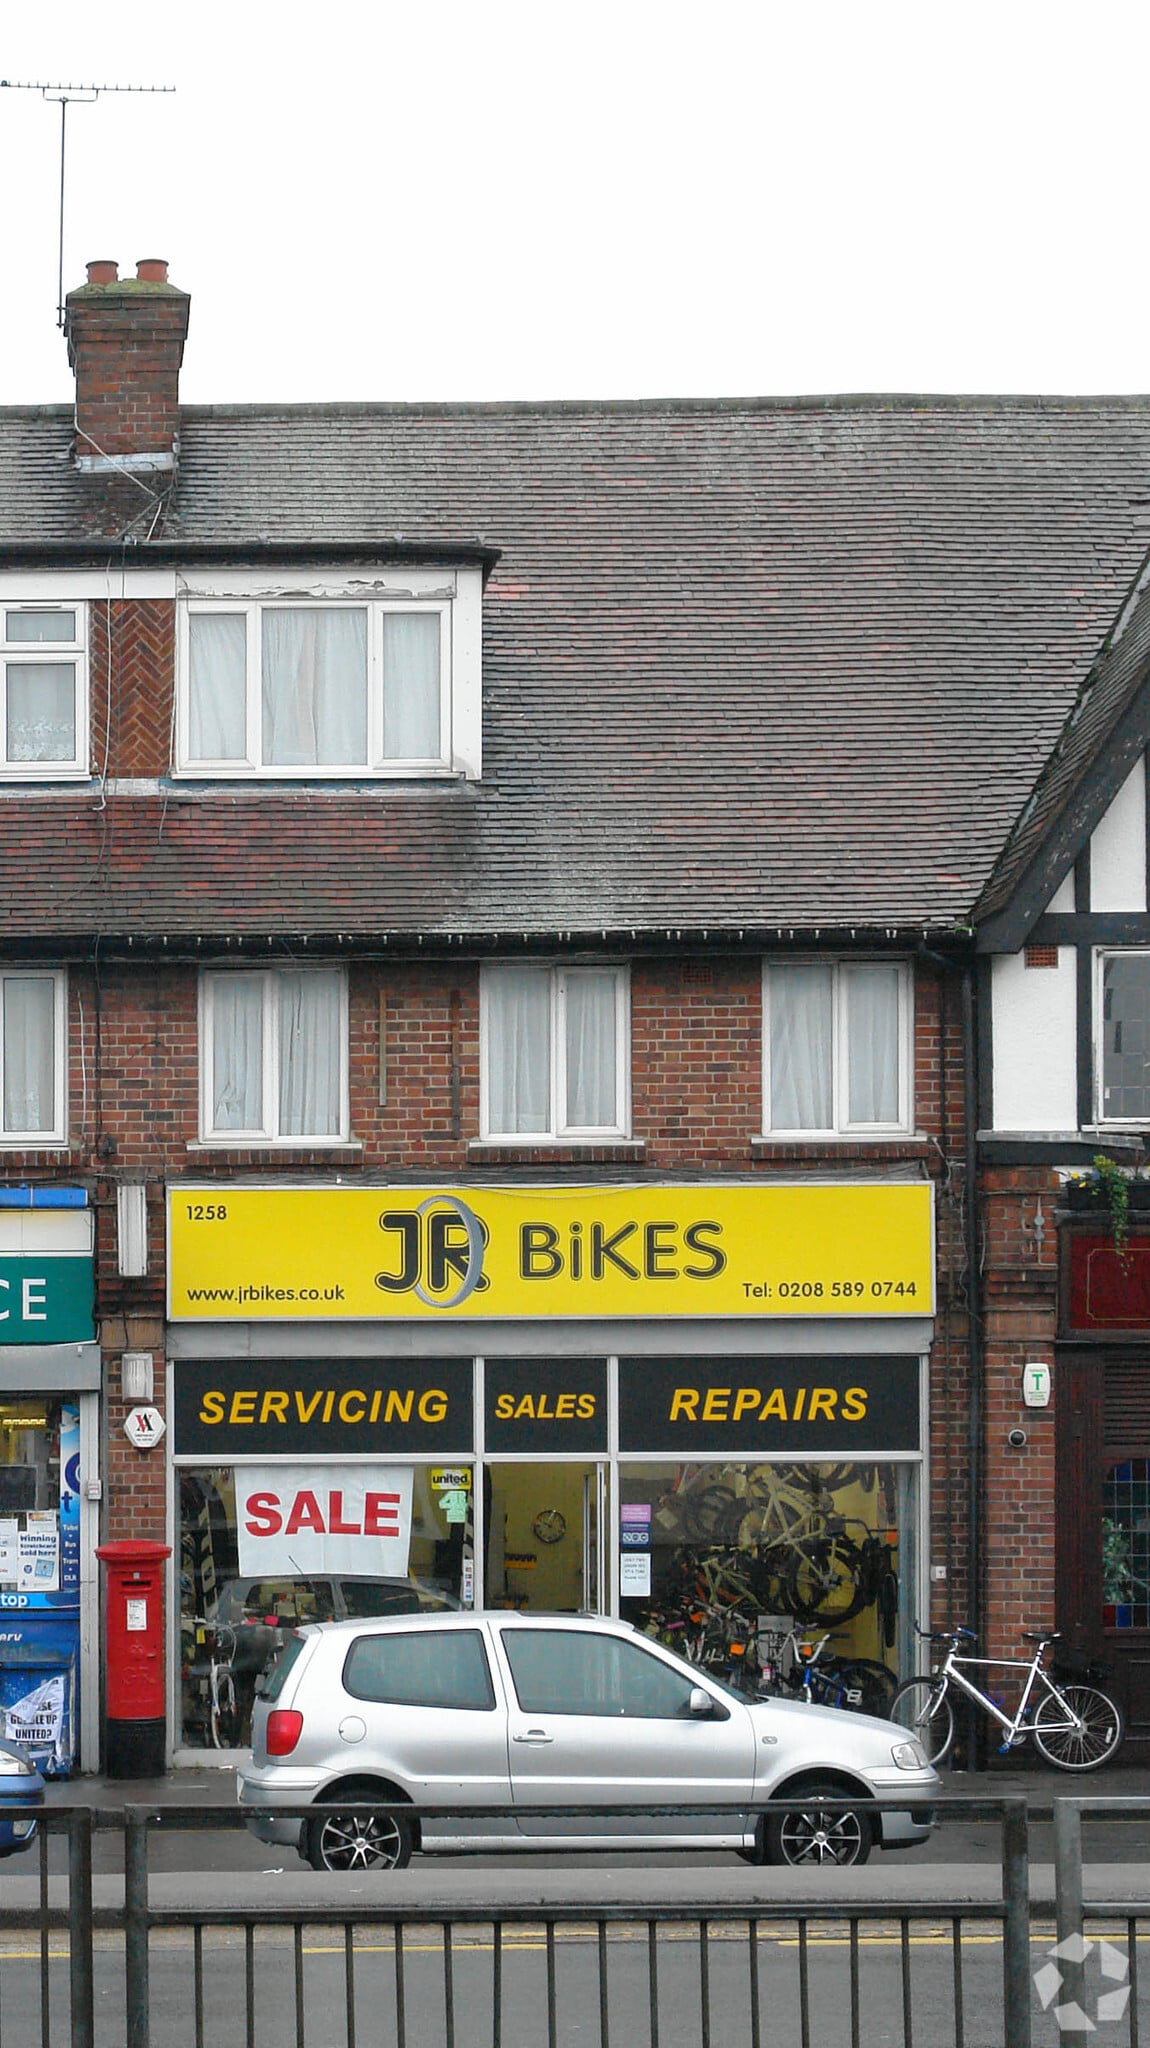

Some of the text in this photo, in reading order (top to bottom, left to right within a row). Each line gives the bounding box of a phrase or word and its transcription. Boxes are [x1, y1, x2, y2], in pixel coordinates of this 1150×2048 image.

[186, 1205, 227, 1221] 1258
[374, 1210, 491, 1294] JR
[187, 1285, 345, 1305] www.jrbikes.co.uk
[742, 1281, 917, 1298] Tel: 0208 589 0744
[199, 1389, 449, 1424] SERVICING
[494, 1393, 596, 1419] SALES
[669, 1387, 868, 1421] REPAIRS
[432, 1473, 468, 1484] united
[246, 1490, 400, 1537] SALE
[20, 1534, 56, 1543] Winning
[46, 1714, 57, 1725] UP
[15, 1728, 52, 1740] UNITED?
